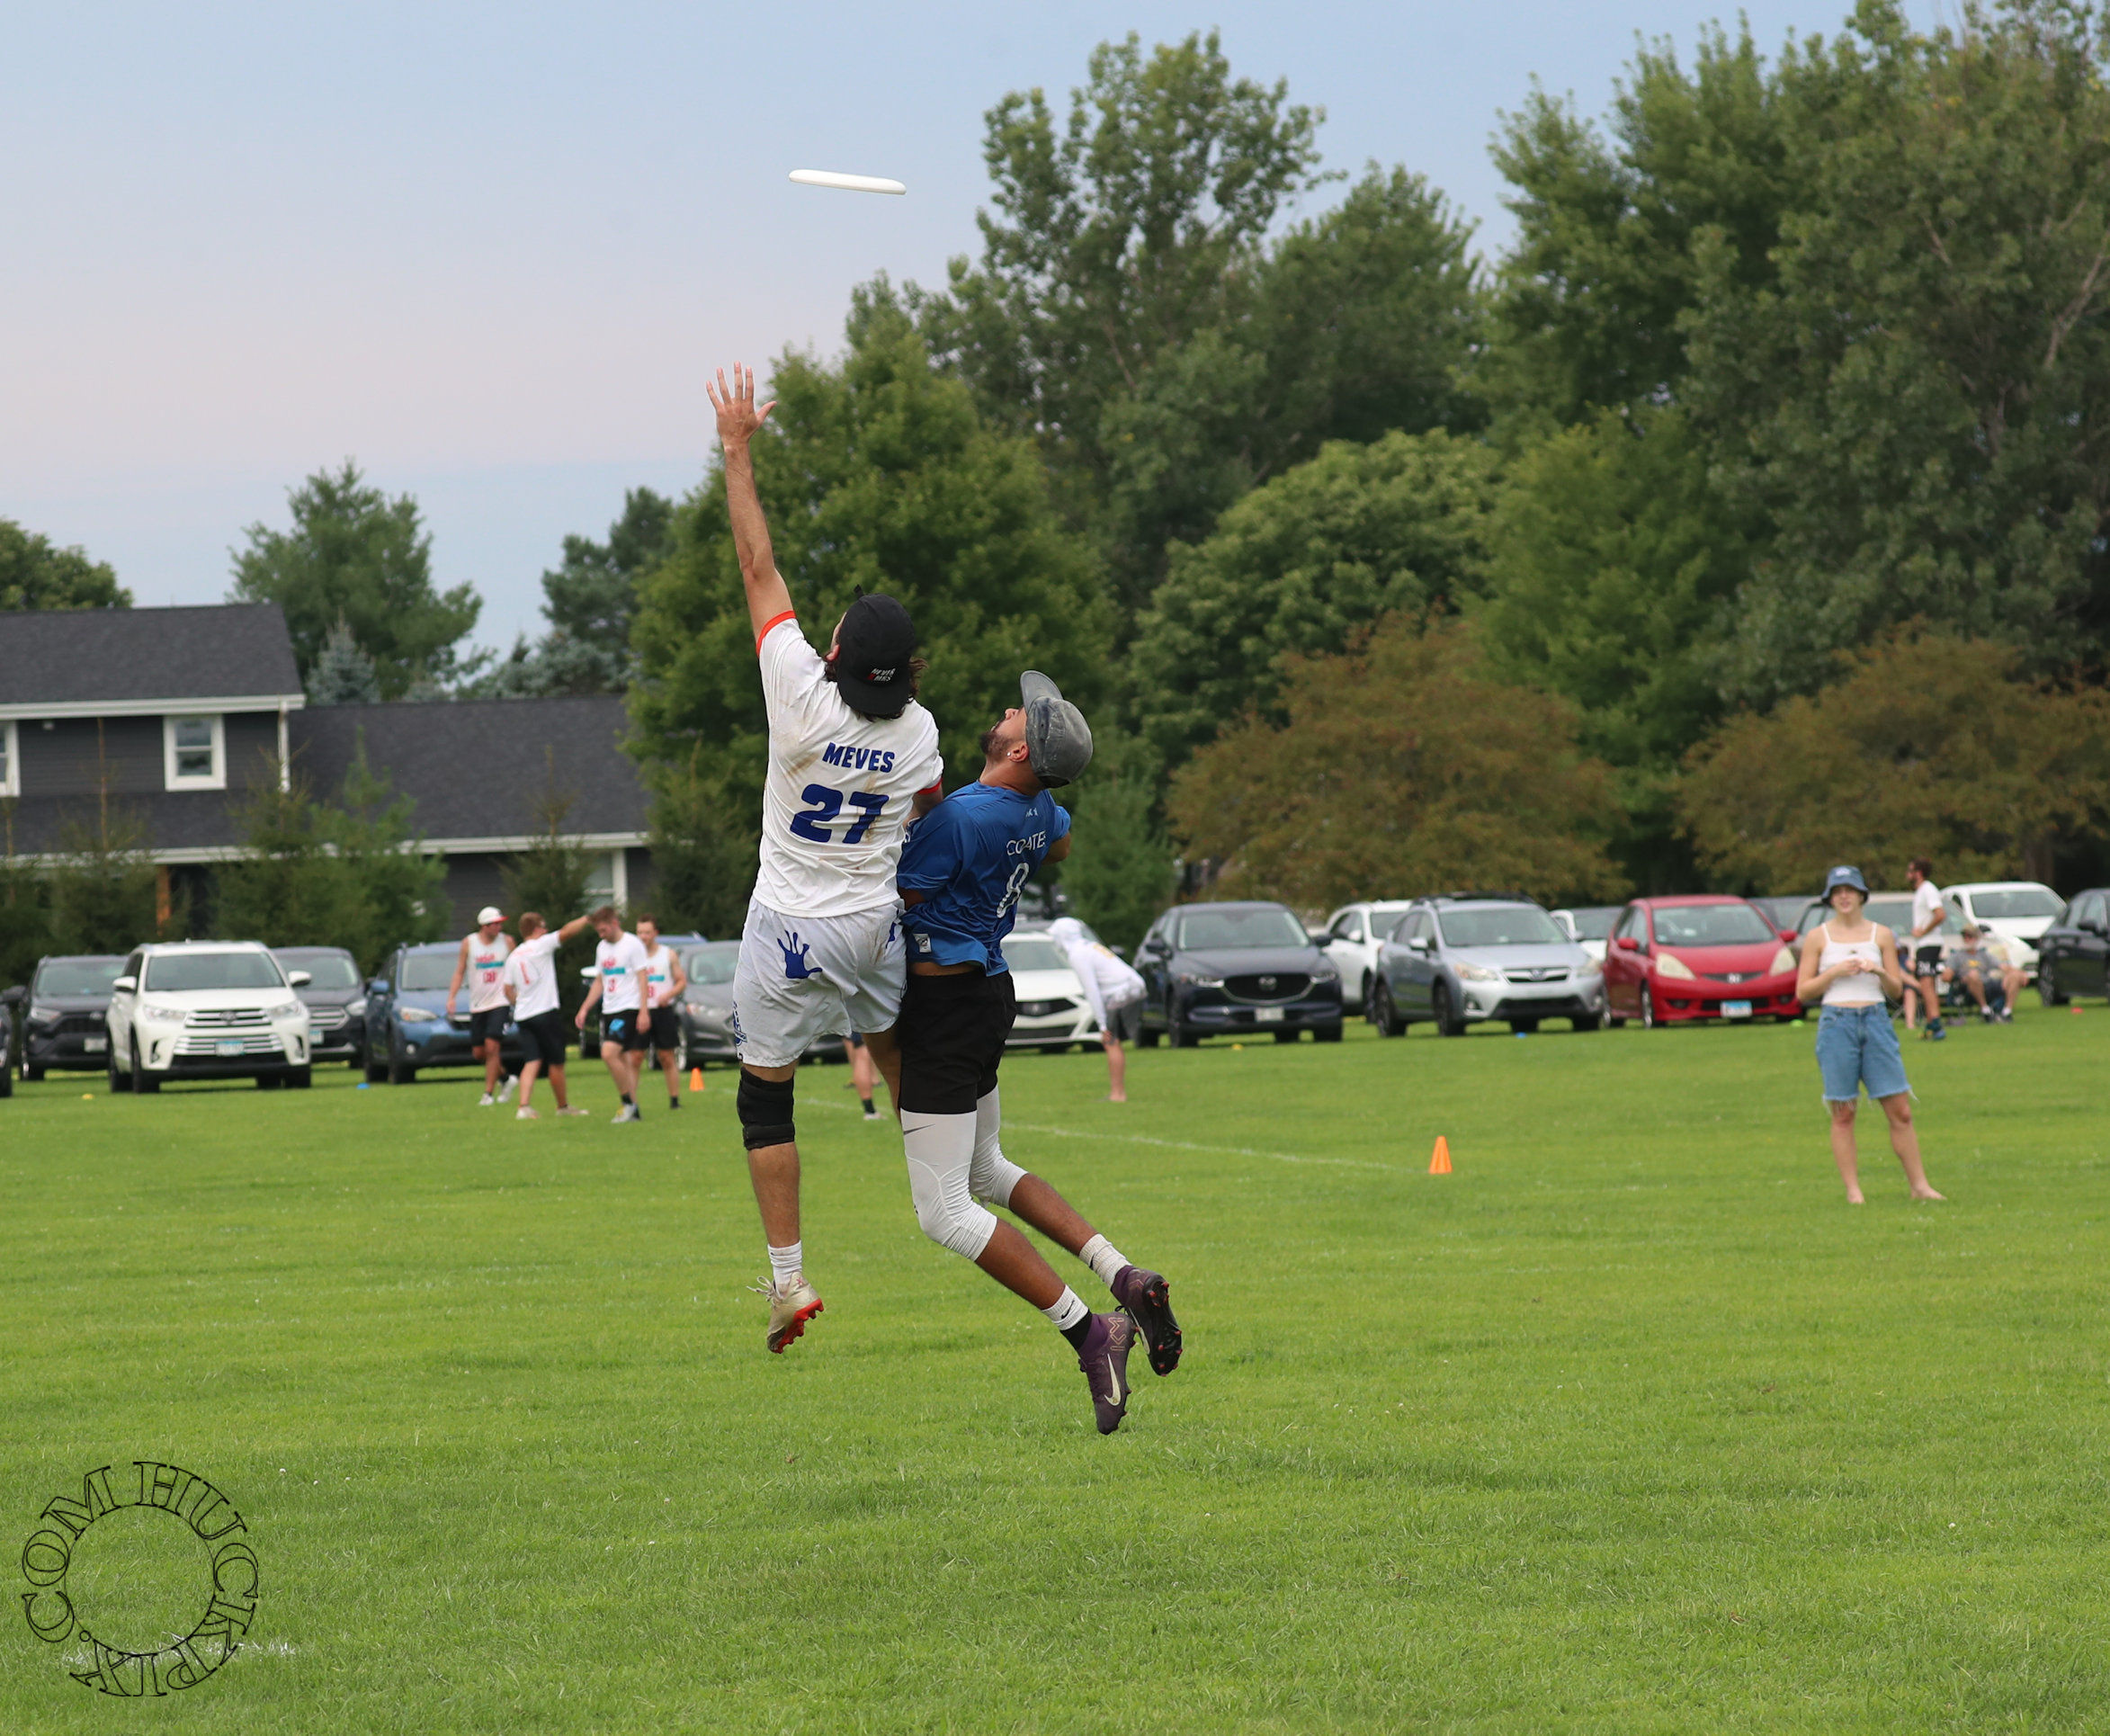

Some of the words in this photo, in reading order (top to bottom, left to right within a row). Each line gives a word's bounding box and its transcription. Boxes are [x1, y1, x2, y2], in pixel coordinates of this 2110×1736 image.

[822, 742, 895, 774] MEVES
[790, 783, 890, 844] 27
[1006, 830, 1047, 856] COATE
[997, 863, 1030, 918] 8
